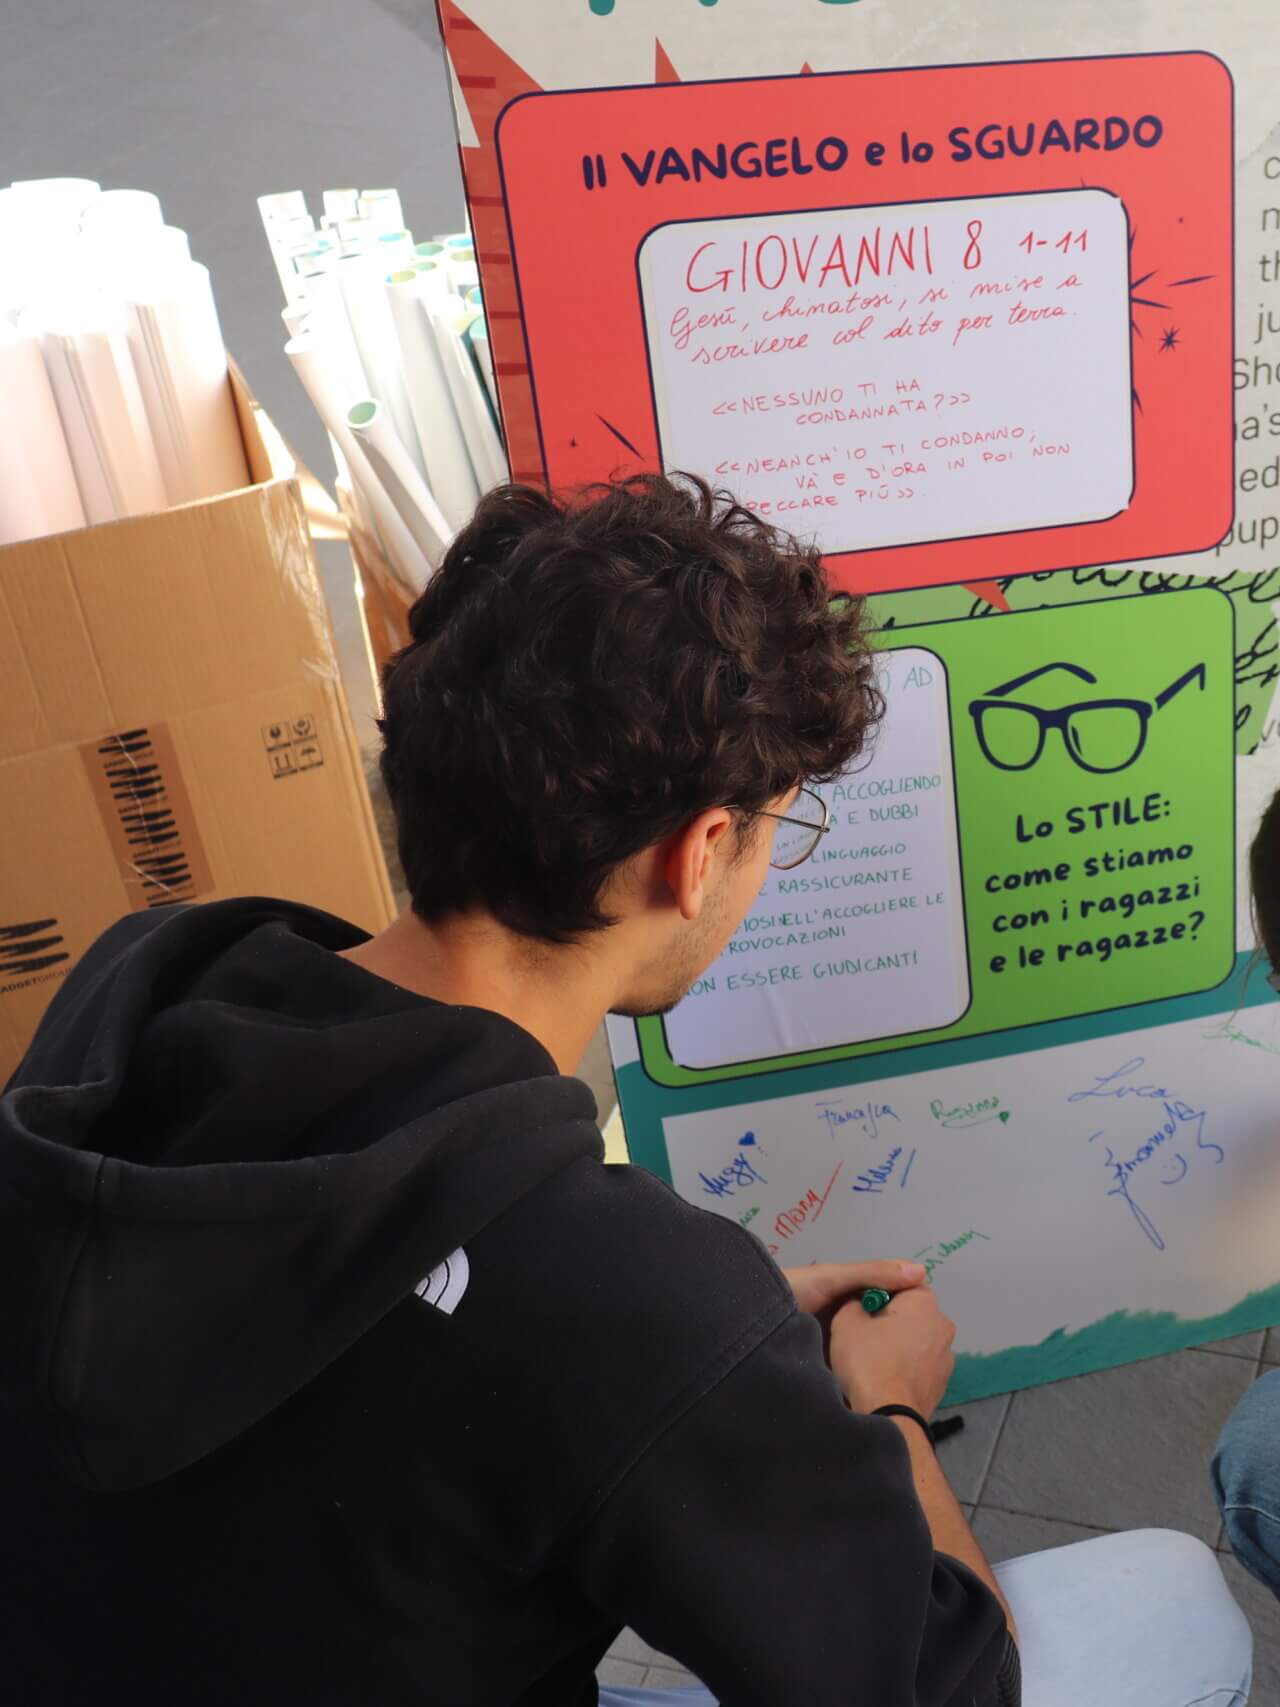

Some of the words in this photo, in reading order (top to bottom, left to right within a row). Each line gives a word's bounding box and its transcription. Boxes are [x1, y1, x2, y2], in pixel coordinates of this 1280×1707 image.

[621, 136, 849, 187] VANGELO
[865, 142, 885, 166] e
[901, 131, 934, 163] lo
[949, 115, 1163, 162] SGUARDO
[686, 226, 932, 293] GIOVANNI
[963, 219, 983, 270] 8
[1018, 229, 1089, 254] 1-11
[1056, 274, 1083, 290] a
[692, 334, 809, 365] scrivere
[833, 315, 875, 345] col
[884, 311, 944, 340] dito
[953, 314, 993, 346] per
[857, 383, 877, 397] TI
[896, 378, 921, 394] HA
[833, 472, 847, 486] E
[866, 462, 927, 480] D'ORA
[948, 457, 966, 470] IN
[982, 451, 1013, 463] POI
[1033, 443, 1071, 457] NON
[882, 443, 904, 456] TI
[745, 495, 839, 515] PECCARE
[903, 666, 934, 689] AD
[832, 775, 941, 802] ACCOGLIENDO
[848, 812, 860, 824] E
[869, 804, 919, 823] DUBBI
[1016, 815, 1053, 843] Lo
[1066, 793, 1171, 834] STILE:
[810, 843, 907, 864] LINGUAGGIO
[985, 863, 1071, 893] come
[1084, 844, 1194, 877] stiamo
[778, 867, 913, 895] RASSICURANTE
[926, 892, 945, 906] LE
[992, 909, 1050, 932] con
[1062, 899, 1069, 920] i
[1081, 876, 1200, 918] ragazzi
[721, 925, 846, 956] ROVOCAZIONI
[990, 955, 1007, 973] e
[1019, 946, 1045, 968] le
[1057, 911, 1205, 962] ragazze?
[727, 964, 803, 992] ESSERE
[812, 951, 919, 979] GIUDICANTI
[1067, 1057, 1176, 1102] Luca
